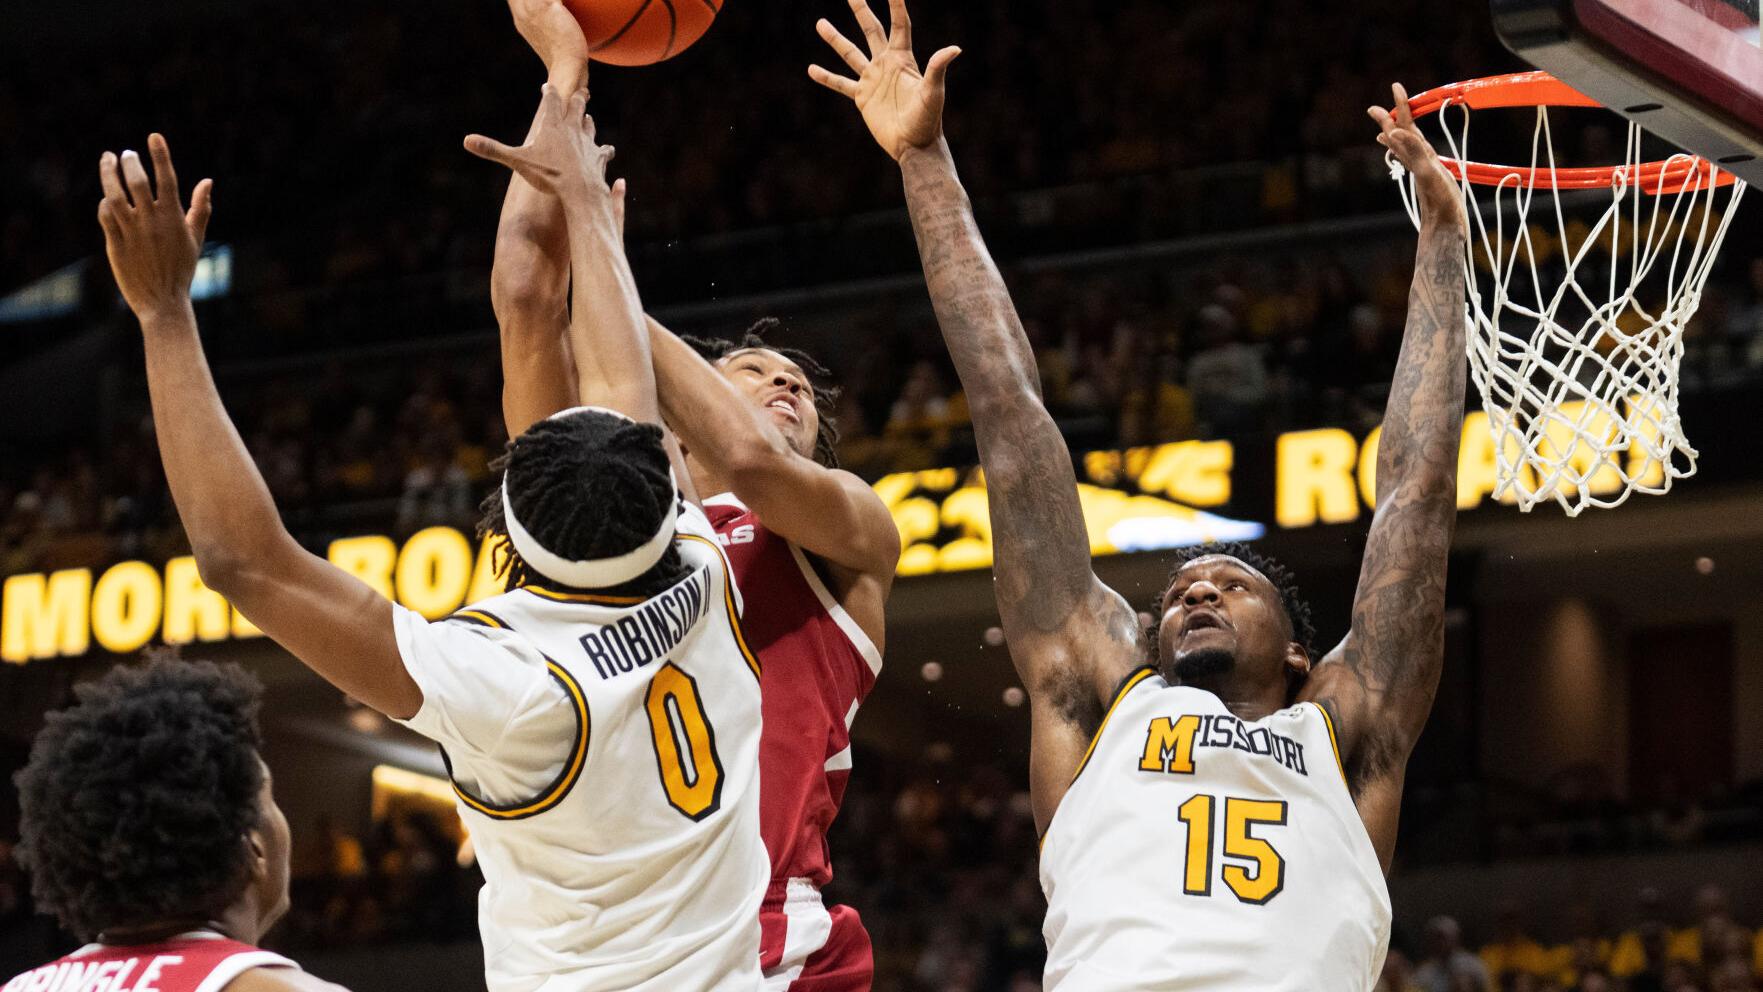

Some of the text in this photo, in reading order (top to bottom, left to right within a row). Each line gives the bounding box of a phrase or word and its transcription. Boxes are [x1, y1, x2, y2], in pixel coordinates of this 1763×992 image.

[1275, 393, 1665, 528] RAR!
[2, 555, 266, 664] MOR
[578, 564, 711, 681] ROBINSON II
[643, 660, 726, 823] 0
[1138, 714, 1309, 777] MISSOURI
[1178, 794, 1289, 906] 15
